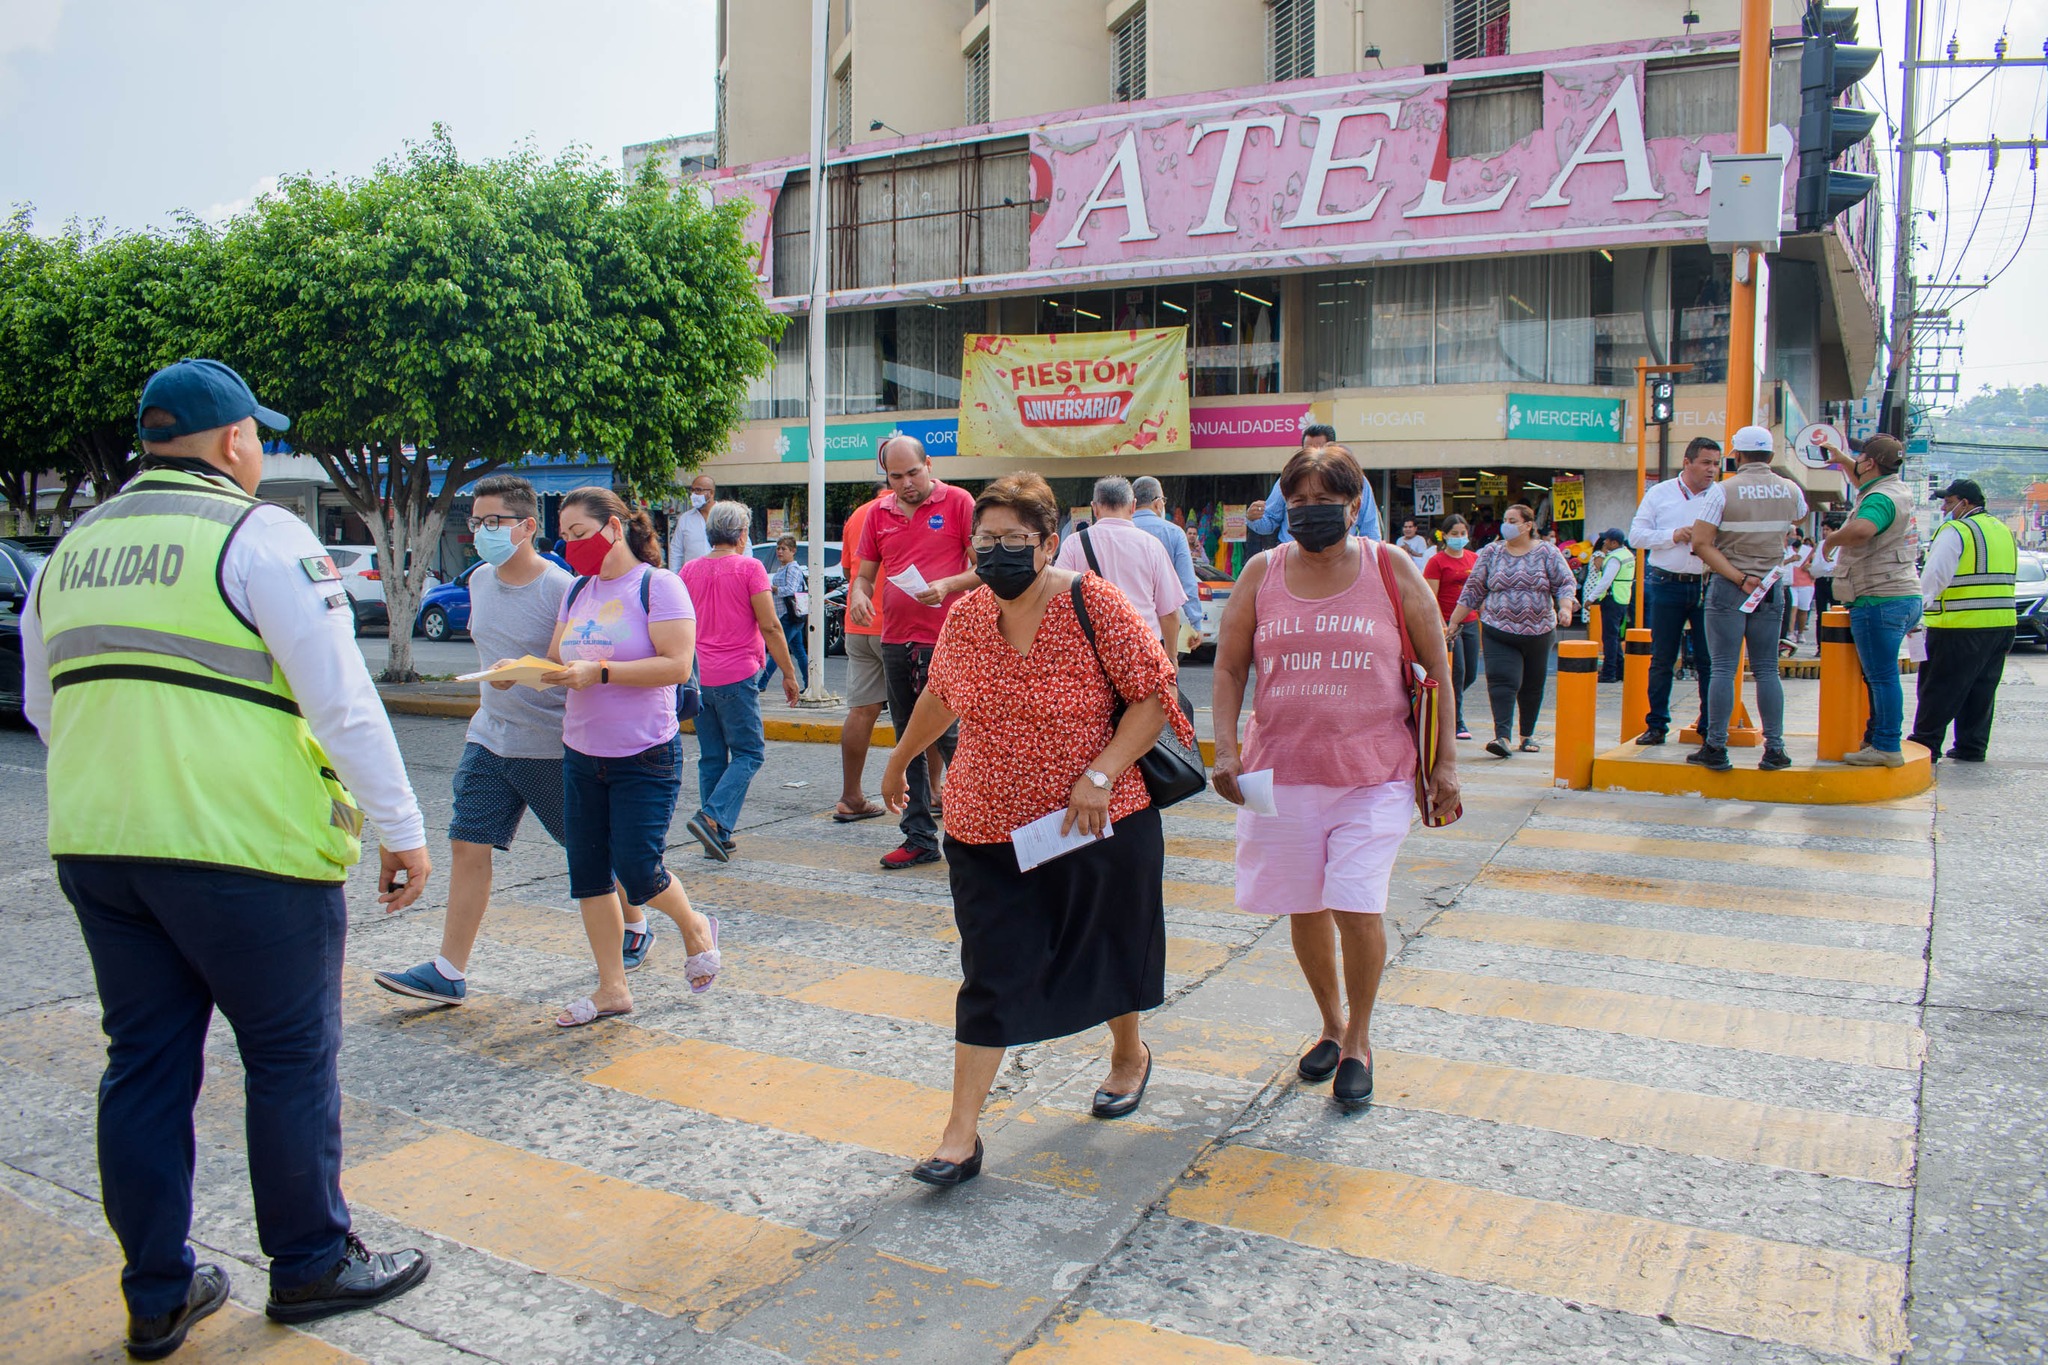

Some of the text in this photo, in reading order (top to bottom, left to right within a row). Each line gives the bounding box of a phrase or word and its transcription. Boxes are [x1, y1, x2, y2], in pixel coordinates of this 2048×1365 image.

[1011, 356, 1138, 390] FIESTÓN
[1023, 396, 1121, 421] ANIVERSARIO
[1190, 418, 1295, 435] ANUALIDADES
[1360, 411, 1425, 427] HOGAR
[1526, 409, 1604, 428] MERCERÍA
[807, 433, 868, 451] RCERÍA
[925, 431, 958, 444] CORT
[1738, 484, 1791, 500] PRENSA
[1421, 495, 1435, 513] 29
[1561, 499, 1576, 518] 29
[60, 544, 184, 592] VIALIDAD
[1260, 615, 1375, 642] STILL DRUNK
[1263, 651, 1373, 674] ON YOUR LOVE
